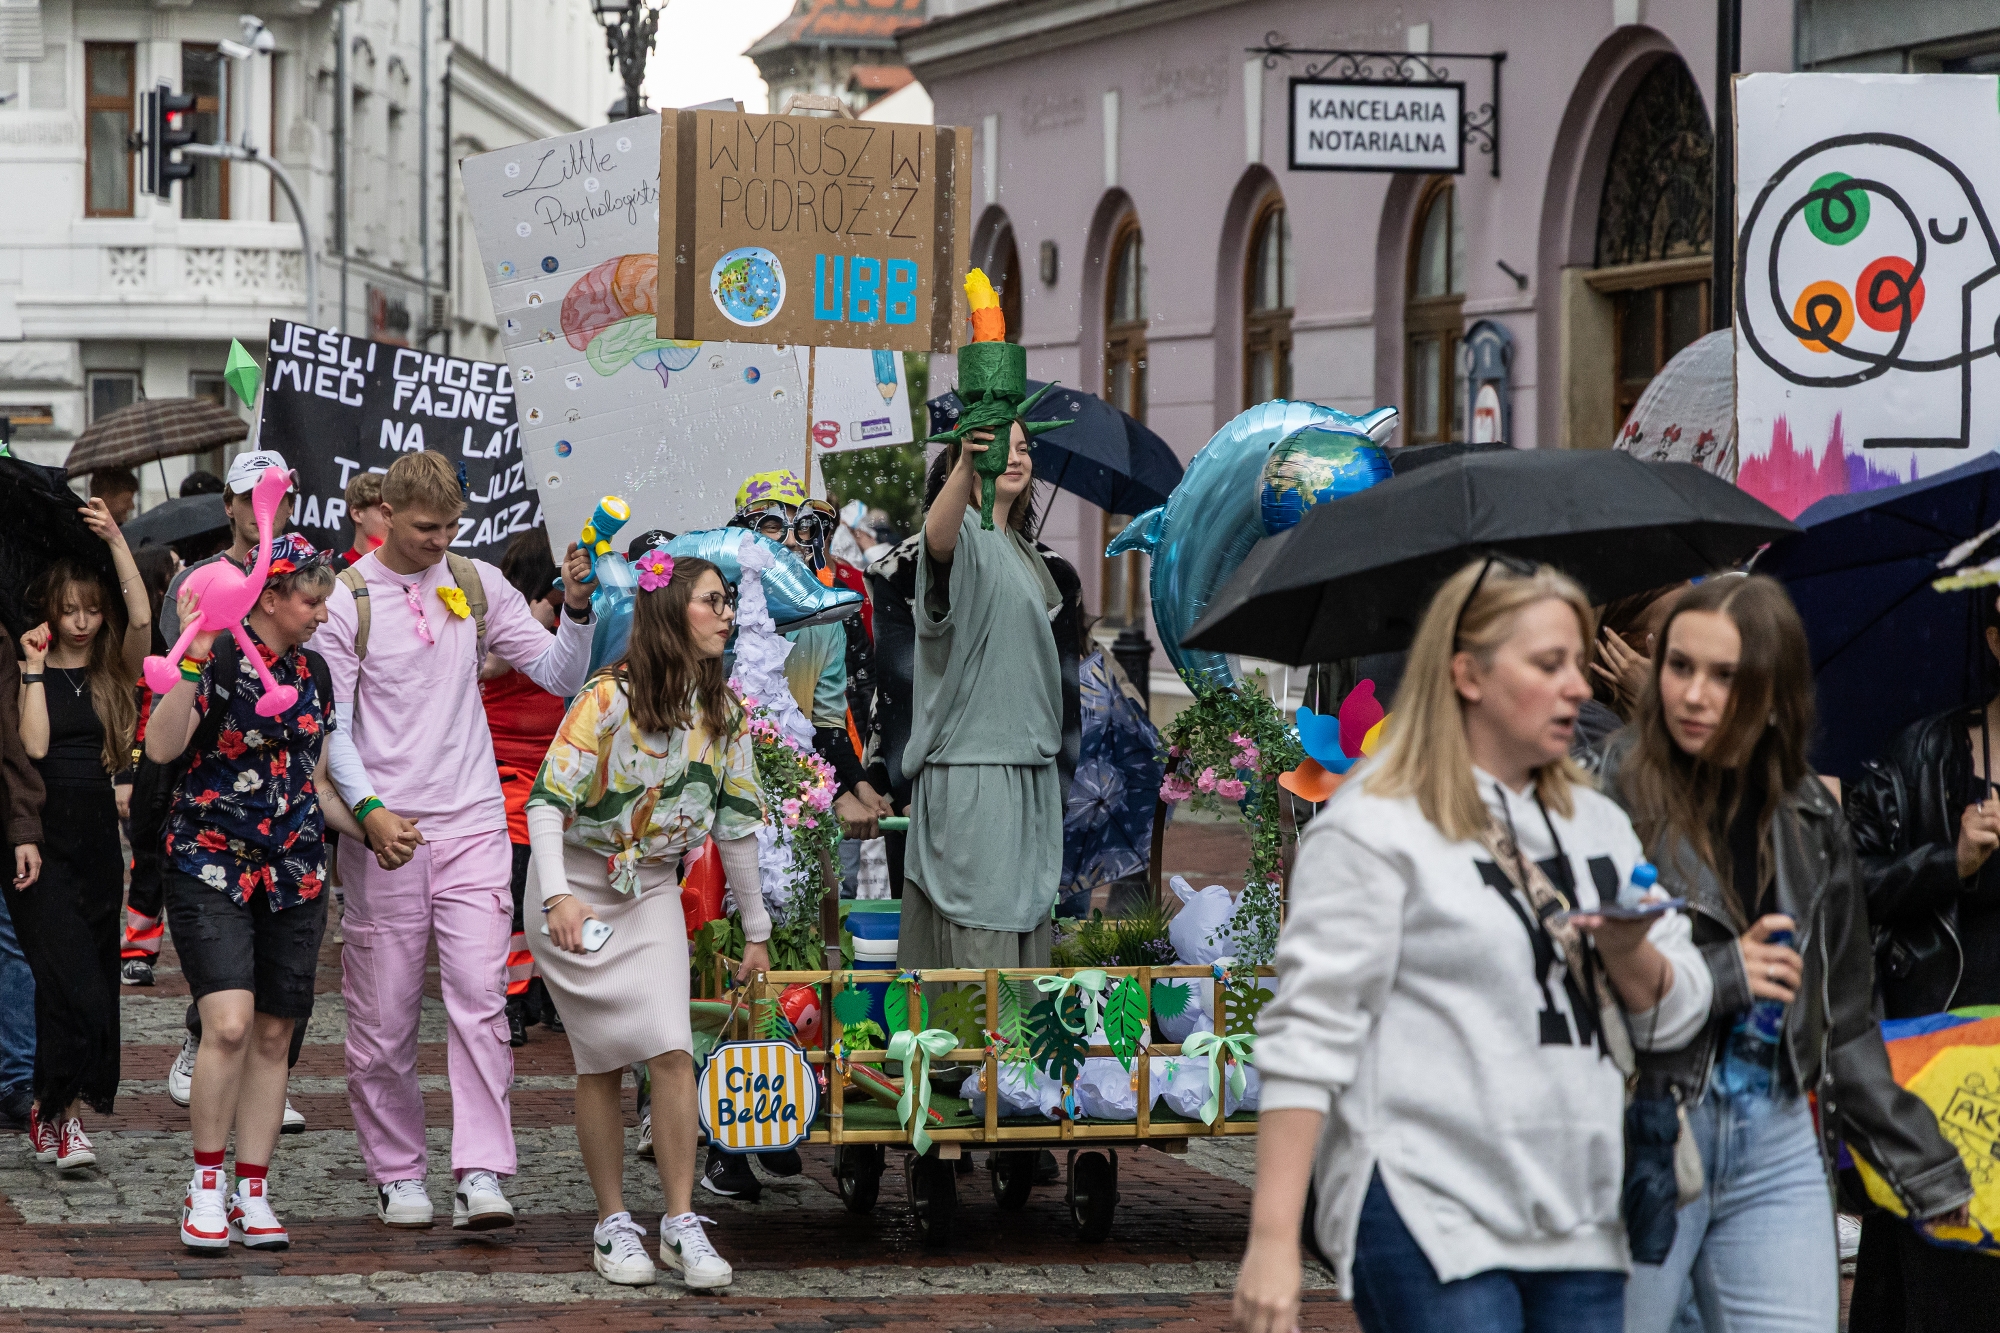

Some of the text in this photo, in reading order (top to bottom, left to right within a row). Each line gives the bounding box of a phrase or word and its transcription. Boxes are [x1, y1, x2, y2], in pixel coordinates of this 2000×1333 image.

[1309, 98, 1445, 121] KANCELARIA
[710, 119, 921, 182] WYRUSZ W
[1309, 130, 1445, 152] NOTARIALNA
[503, 138, 617, 197] Little
[721, 176, 918, 238] PODRÓŻ Z
[814, 254, 918, 324] UBB
[271, 323, 377, 373] JEŚLI
[393, 381, 512, 426] FAJNE
[379, 419, 522, 459] NA LAT
[726, 1066, 784, 1093] Ciao
[717, 1094, 798, 1126] Bella
[1953, 1101, 2000, 1135] AK
